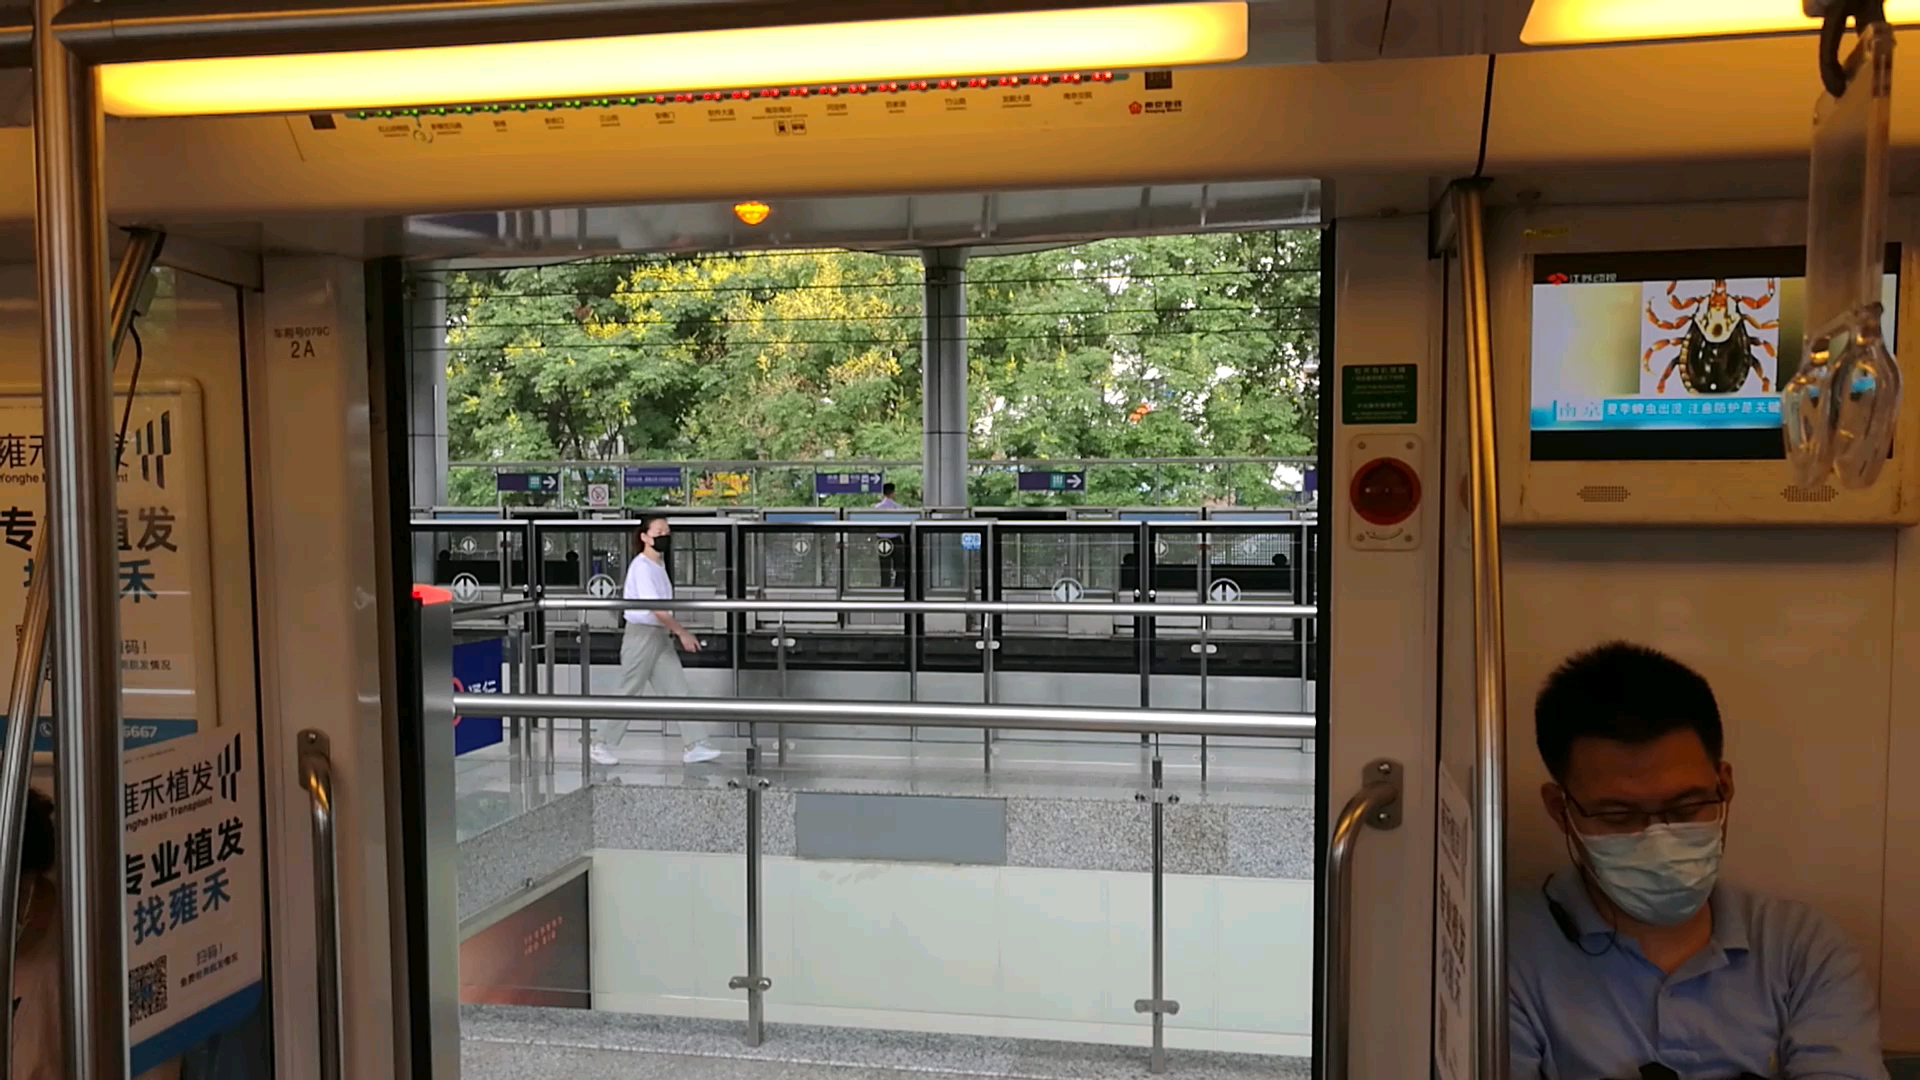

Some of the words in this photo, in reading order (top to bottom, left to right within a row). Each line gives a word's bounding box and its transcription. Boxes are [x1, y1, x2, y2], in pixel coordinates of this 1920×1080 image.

[1559, 402, 1601, 418] 南京
[133, 868, 230, 946] 找雍禾
